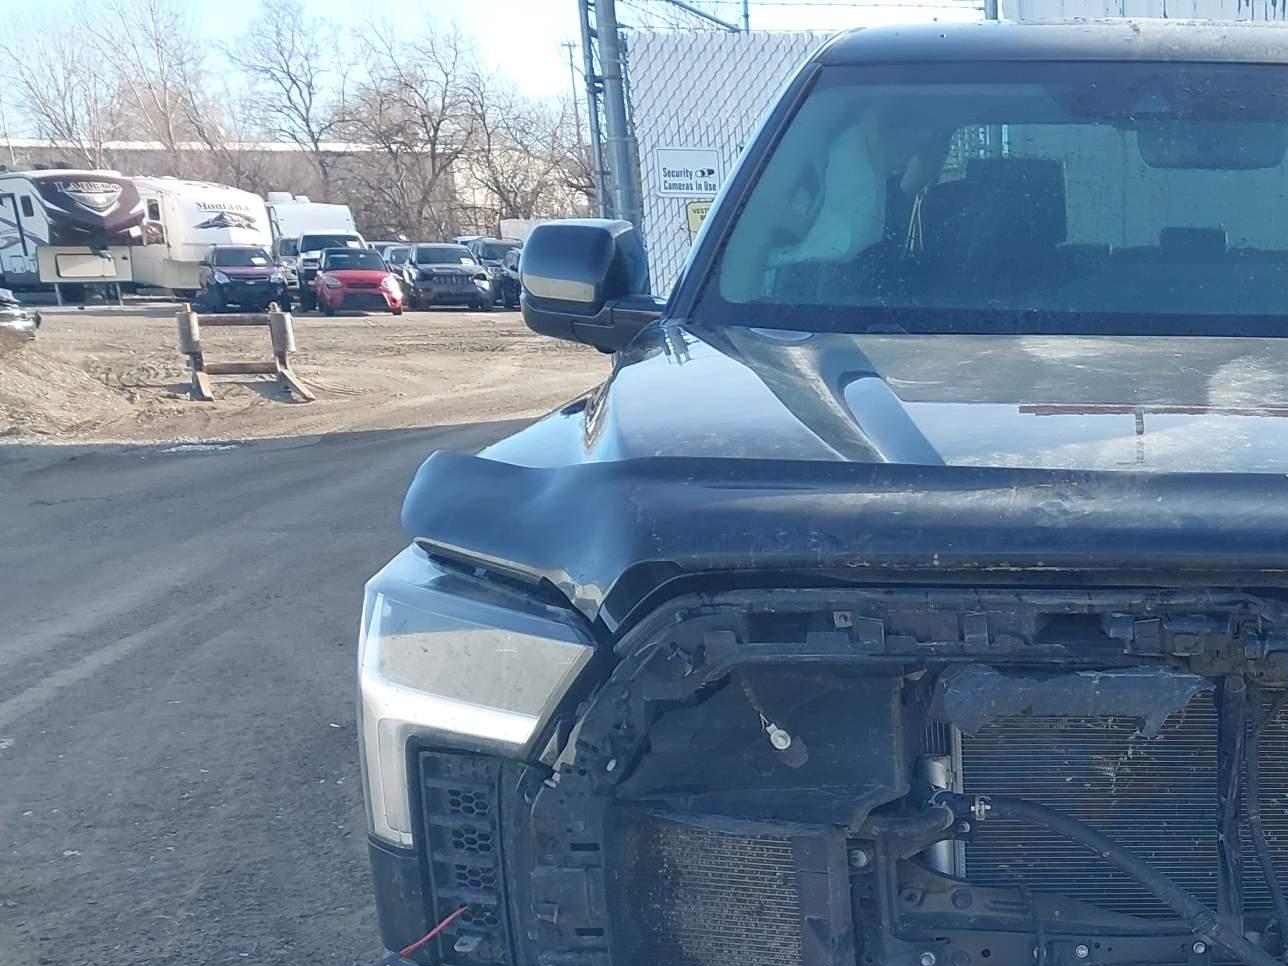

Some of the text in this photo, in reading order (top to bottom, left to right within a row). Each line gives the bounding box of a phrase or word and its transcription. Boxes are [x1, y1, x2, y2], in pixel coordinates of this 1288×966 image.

[663, 167, 693, 180] Security
[664, 180, 694, 191] Cameras
[704, 181, 717, 191] Use
[196, 202, 250, 212] Montana
